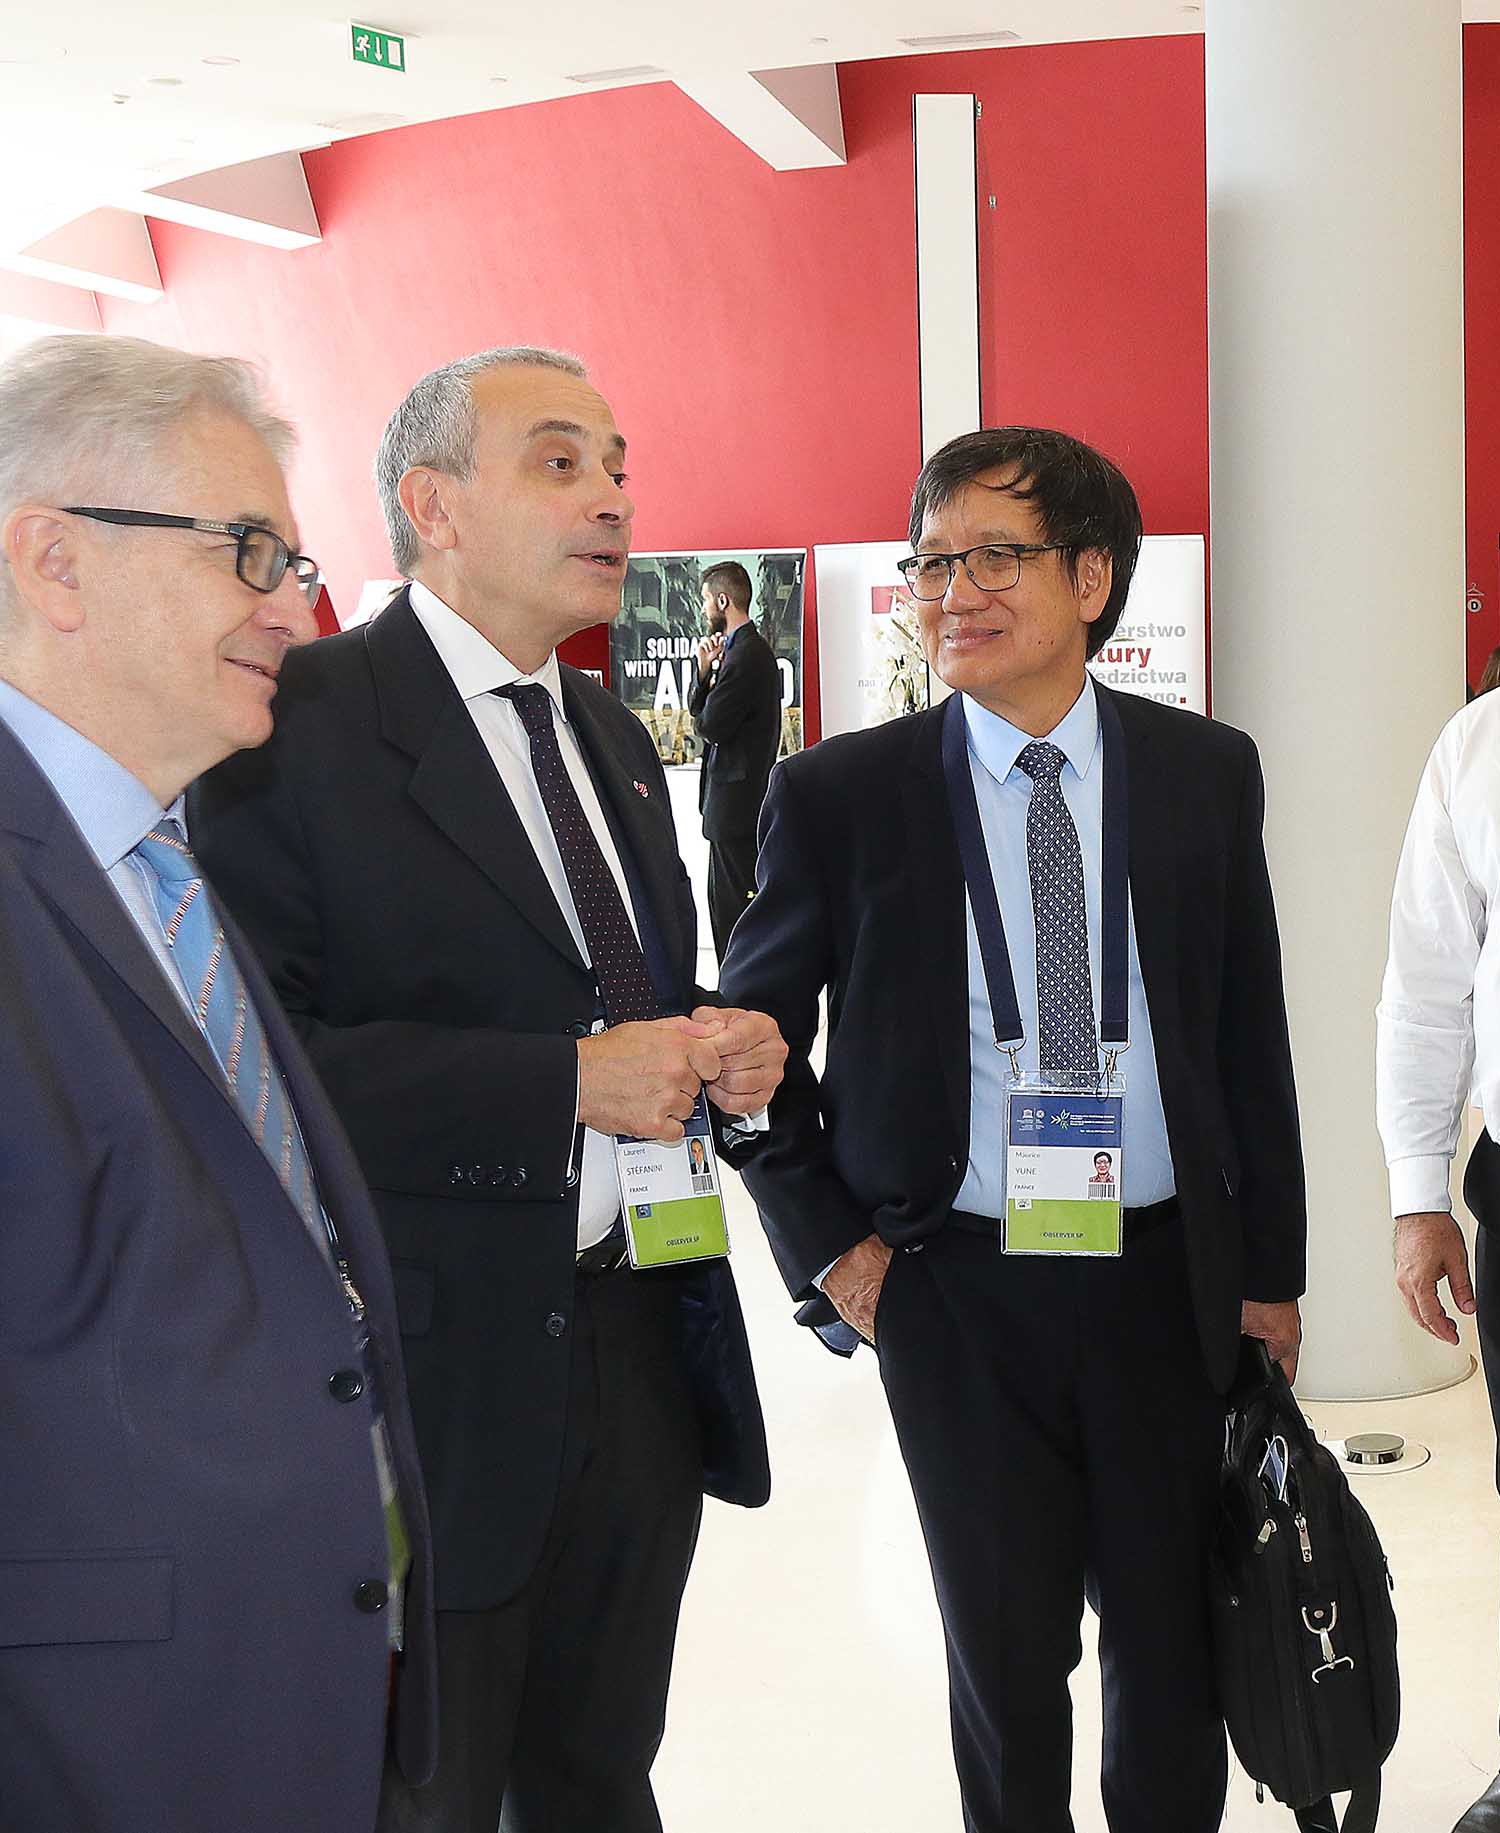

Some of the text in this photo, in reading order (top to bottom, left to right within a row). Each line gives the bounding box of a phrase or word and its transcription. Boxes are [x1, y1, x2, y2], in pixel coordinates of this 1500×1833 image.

[1115, 623, 1186, 638] erstwo
[646, 637, 700, 659] SOLIDA
[1097, 647, 1152, 668] tury
[623, 660, 656, 678] WITH
[1095, 669, 1187, 684] edzictwa
[1015, 1167, 1037, 1175] YUNE
